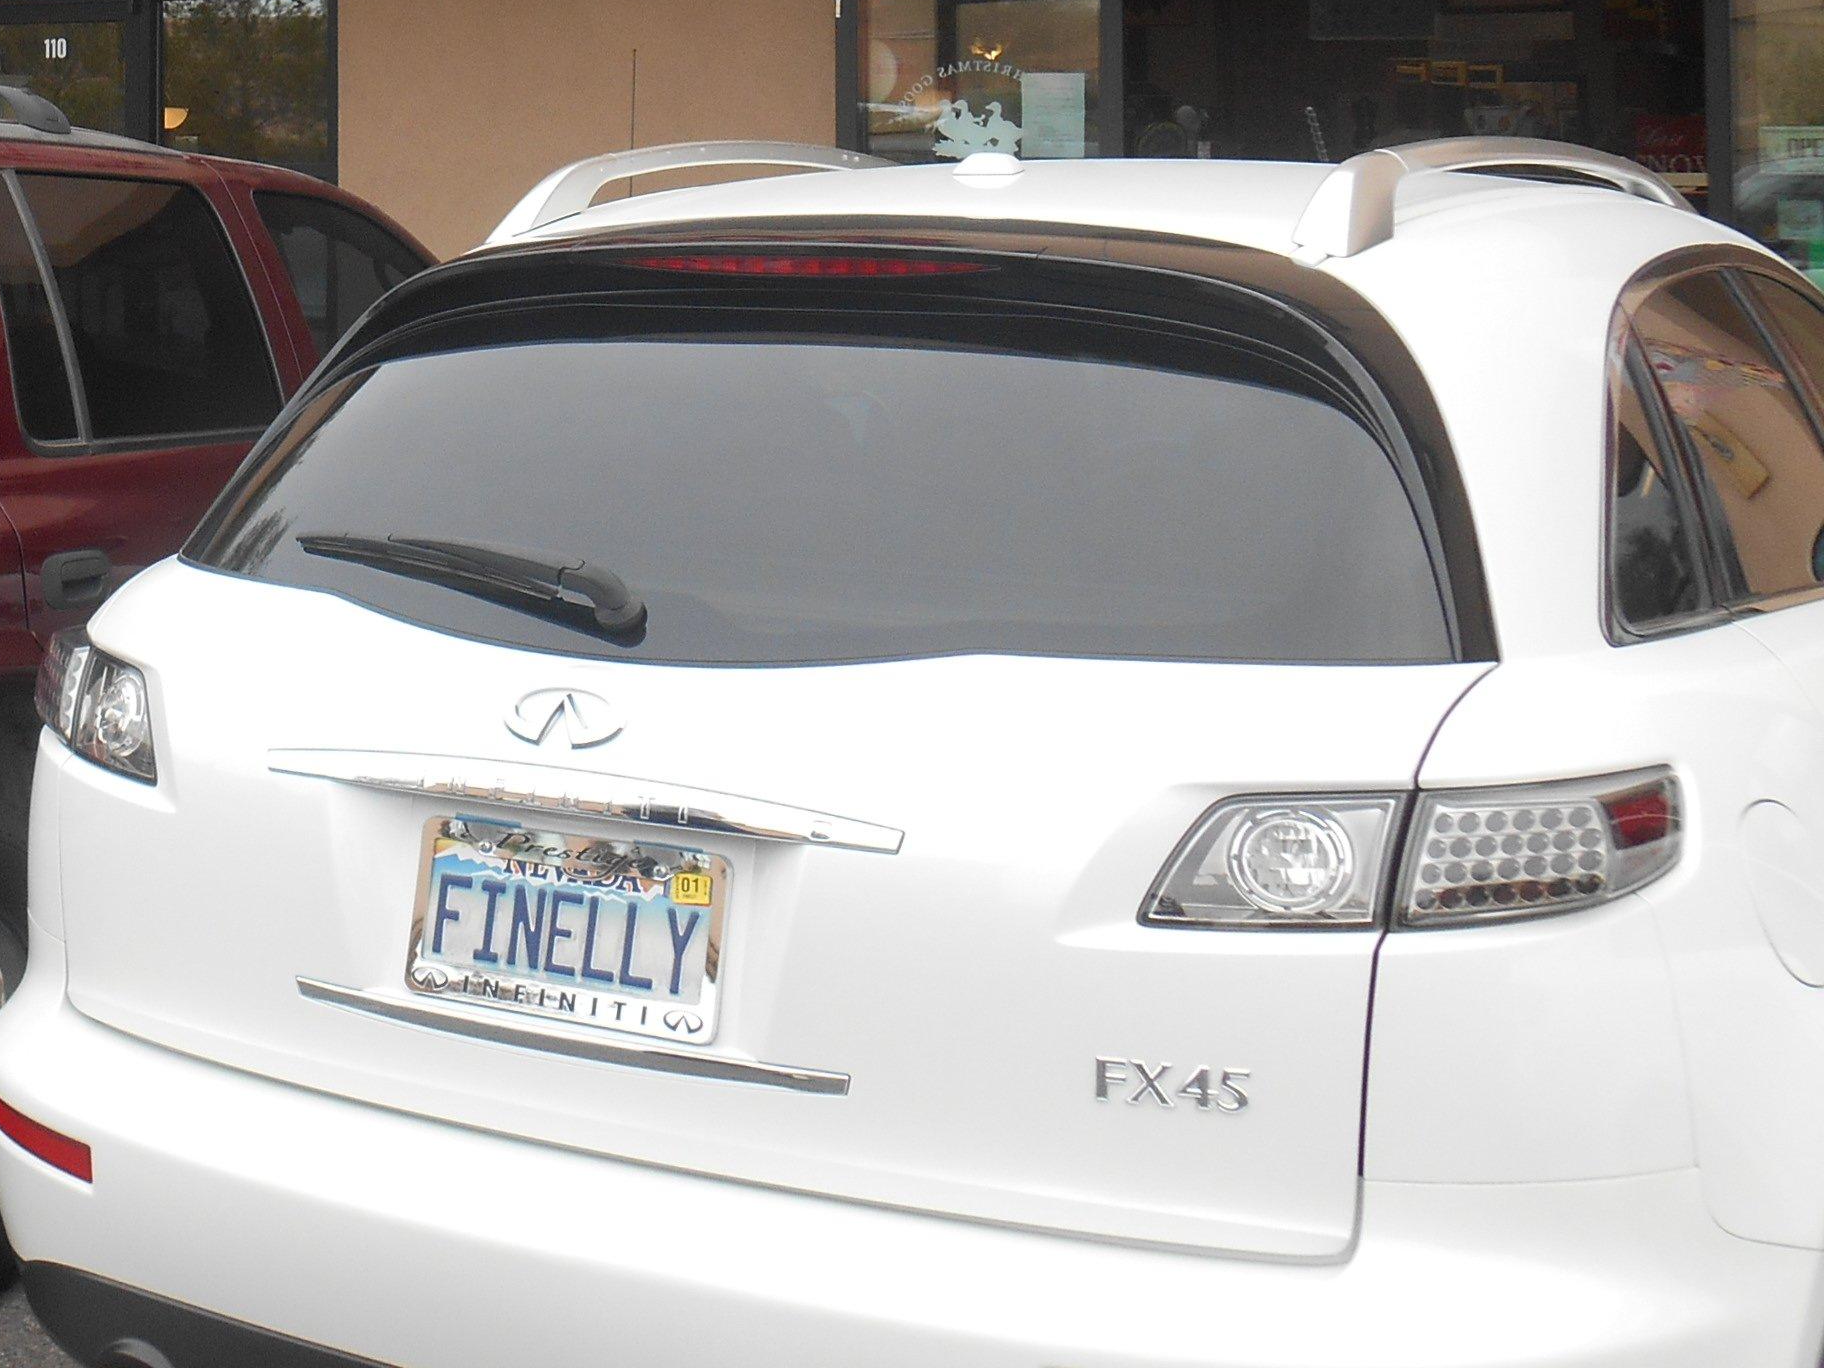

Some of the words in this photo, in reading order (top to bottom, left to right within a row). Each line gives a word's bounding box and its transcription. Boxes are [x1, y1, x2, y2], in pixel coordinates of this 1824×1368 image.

[44, 38, 67, 59] 110
[681, 877, 699, 893] 01
[431, 874, 701, 995] FINELLY
[462, 975, 647, 1025] INFINITI
[1095, 1055, 1251, 1114] FX45
